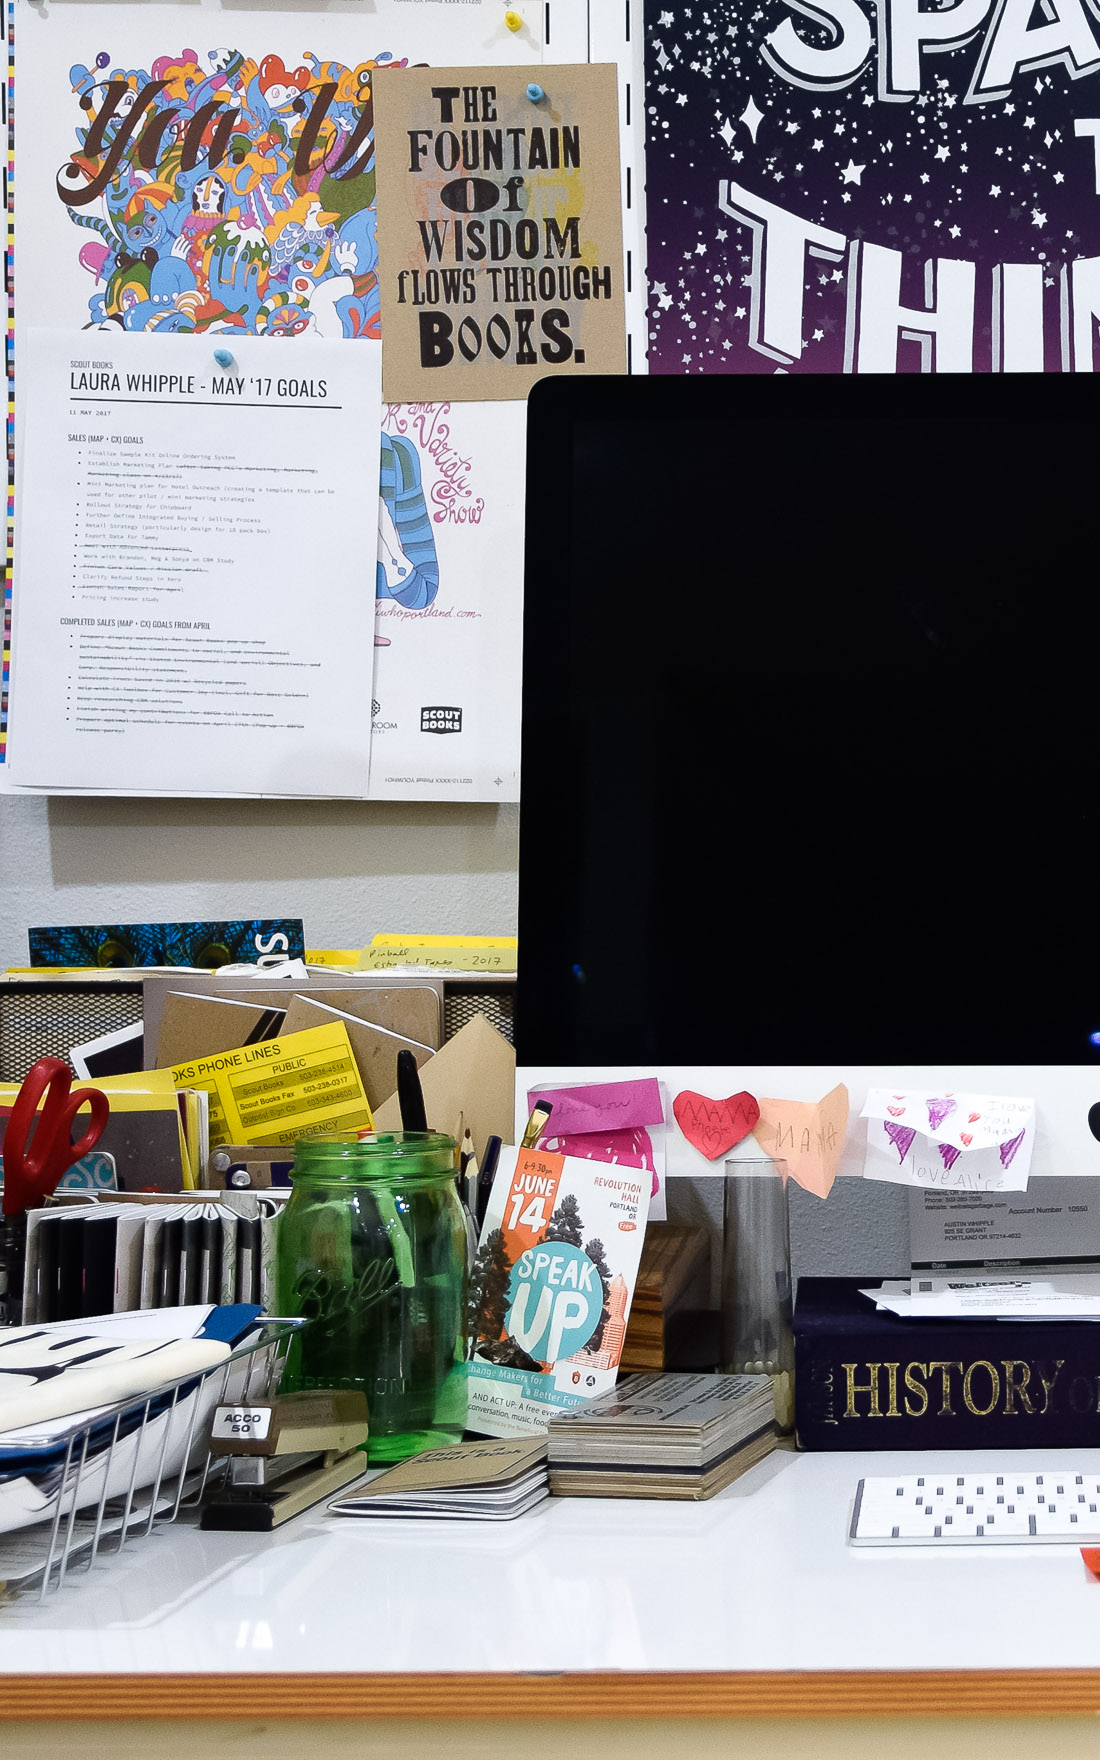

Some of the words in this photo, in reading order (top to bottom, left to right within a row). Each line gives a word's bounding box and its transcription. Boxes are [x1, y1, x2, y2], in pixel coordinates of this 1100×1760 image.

[432, 86, 497, 123] THE
[407, 126, 581, 172] FOUNTAIN
[416, 217, 582, 263] WISDOM
[487, 266, 612, 303] THROUGH
[419, 308, 586, 368] BOOKS.
[70, 360, 91, 369] SCOUT
[93, 361, 114, 370] BOOKS
[71, 372, 121, 391] LAURA
[127, 374, 196, 393] WHIPPLE
[212, 376, 245, 395] MAY
[277, 379, 328, 398] GOALS
[68, 434, 87, 443] SALES
[123, 436, 144, 445] GOALS
[431, 480, 485, 525] Show
[60, 617, 96, 627] COMPLETED
[97, 618, 116, 627] SALES
[152, 620, 173, 629] GOALS
[174, 620, 192, 630] FROM
[193, 621, 211, 630] APRIL
[422, 710, 460, 721] SCOUT
[422, 720, 460, 731] BOOKS
[306, 955, 326, 965] 017
[472, 955, 502, 966] 2017
[172, 1069, 196, 1083] OKS
[198, 1054, 243, 1075] PHONE
[244, 1044, 281, 1063] LINES
[271, 1058, 307, 1074] PUBLIC
[239, 1100, 260, 1111] Scout
[260, 1095, 281, 1106] Books
[282, 1090, 295, 1100] Fax
[303, 1077, 348, 1094] 503-238-0317
[242, 1085, 262, 1096] Scout
[263, 1080, 284, 1092] Books
[242, 1110, 269, 1124] Outpost
[270, 1107, 285, 1119] Sign
[279, 1120, 338, 1144] EMERGENCY
[913, 1154, 950, 1185] love
[513, 1173, 557, 1198] JUNE
[594, 1176, 642, 1193] REVOLUTION
[609, 1202, 638, 1213] PORTLAND
[621, 1192, 639, 1205] HALL
[507, 1192, 548, 1234] 14
[1008, 1207, 1035, 1215] Account
[1036, 1206, 1063, 1214] Number
[1068, 1205, 1088, 1213] 10550
[518, 1249, 598, 1292] SPEAK
[508, 1281, 590, 1364] UP
[500, 1370, 529, 1383] Makers
[530, 1374, 544, 1385] for
[533, 1388, 561, 1403] Better
[841, 1359, 1065, 1418] HISTORY
[472, 1392, 489, 1400] AND
[489, 1396, 505, 1405] ACT
[524, 1403, 541, 1414] free
[223, 1413, 262, 1423] ACCO
[467, 1403, 509, 1419] conversation,
[511, 1413, 532, 1425] music,
[231, 1424, 251, 1433] 50
